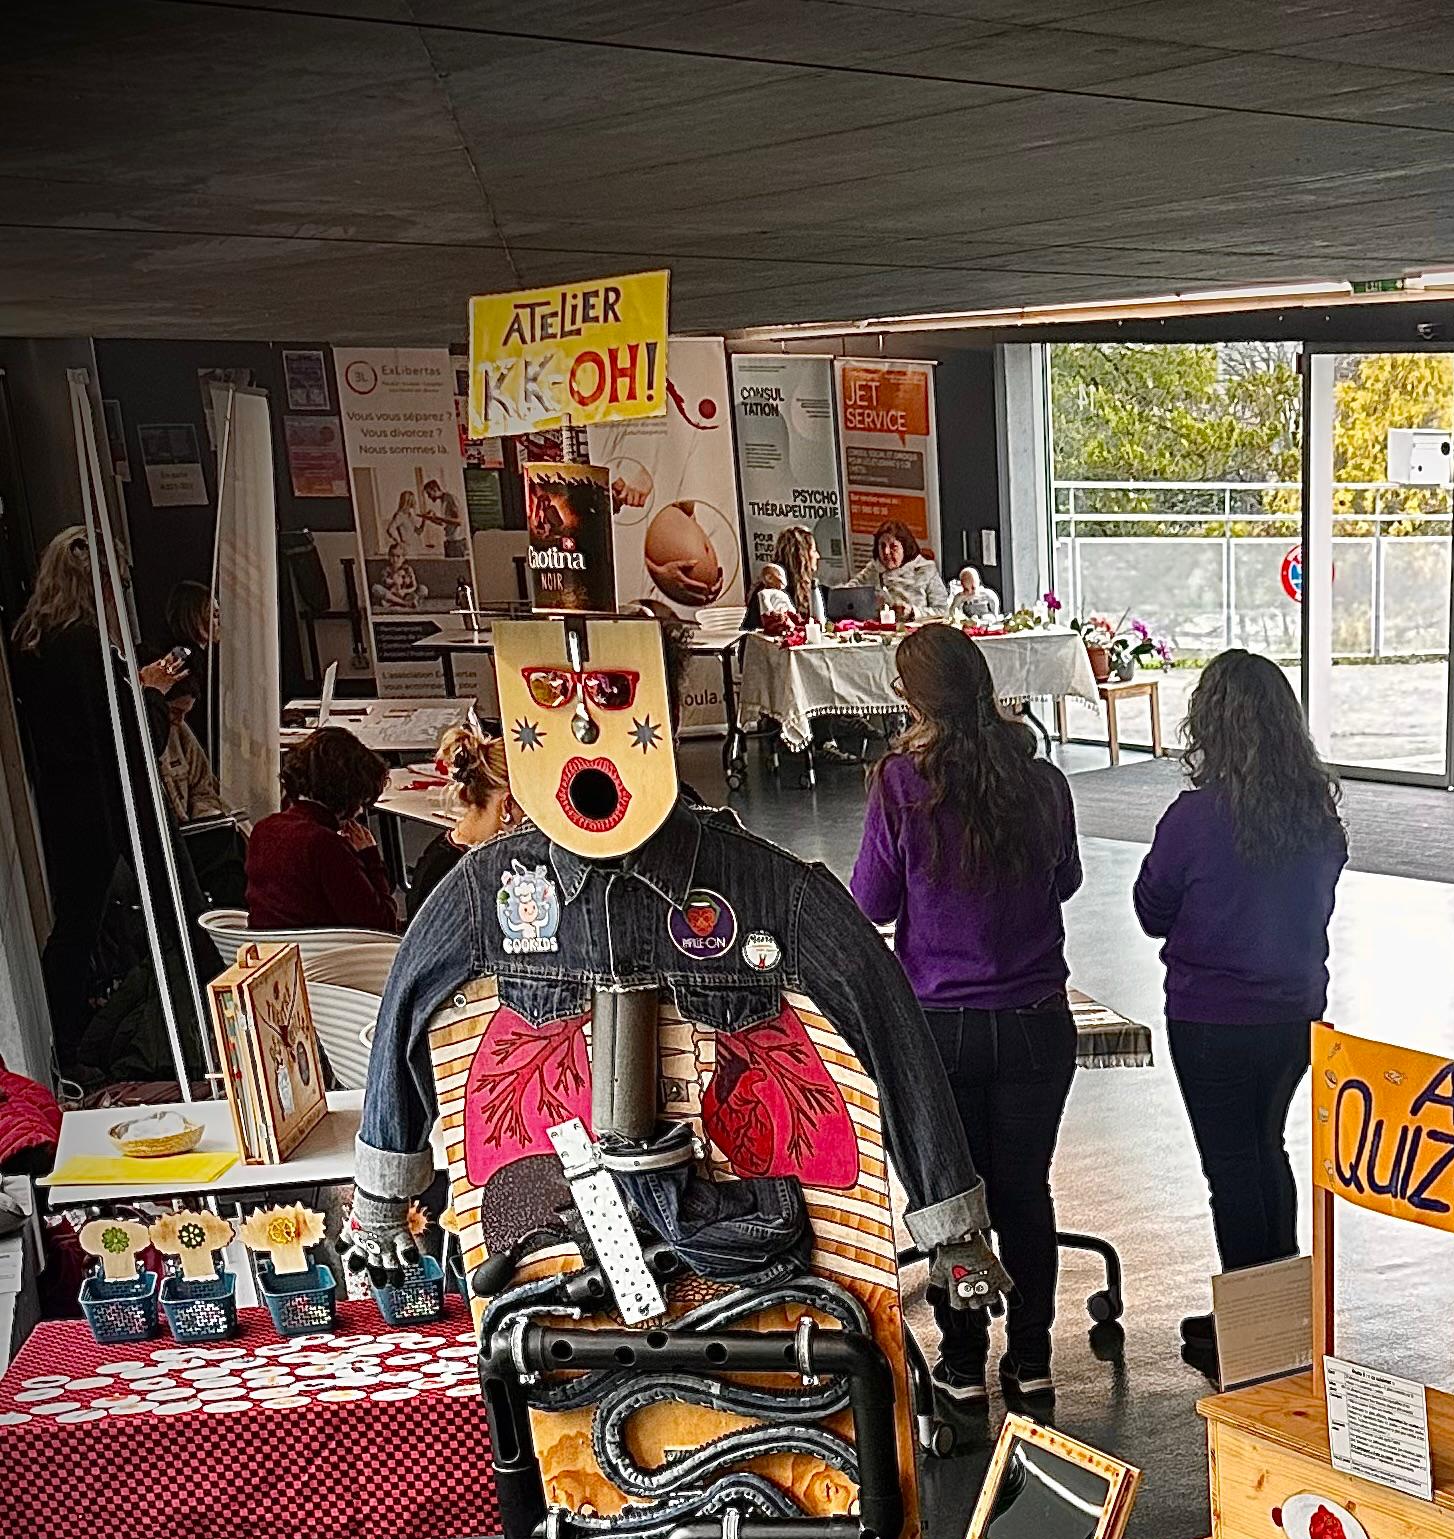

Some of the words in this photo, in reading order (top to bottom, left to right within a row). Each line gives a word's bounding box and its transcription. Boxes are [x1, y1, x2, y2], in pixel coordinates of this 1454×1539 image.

[502, 286, 622, 347] ATELIER
[381, 365, 441, 376] ExLibertas
[740, 386, 785, 402] CONSUL
[846, 381, 880, 406] JET
[346, 410, 373, 421] Vous
[375, 412, 401, 421] vous
[402, 411, 444, 423] séparez
[742, 402, 780, 417] TATION
[846, 408, 907, 431] SERVICE
[361, 428, 388, 438] Vous
[389, 427, 434, 438] divorcez
[359, 444, 388, 455] Nous
[389, 446, 436, 455] sommes
[793, 489, 838, 505] PSYCHO
[749, 501, 839, 519] THÉRAPEUTIQUE
[528, 545, 586, 570] Caotina
[541, 572, 564, 590] NOIR
